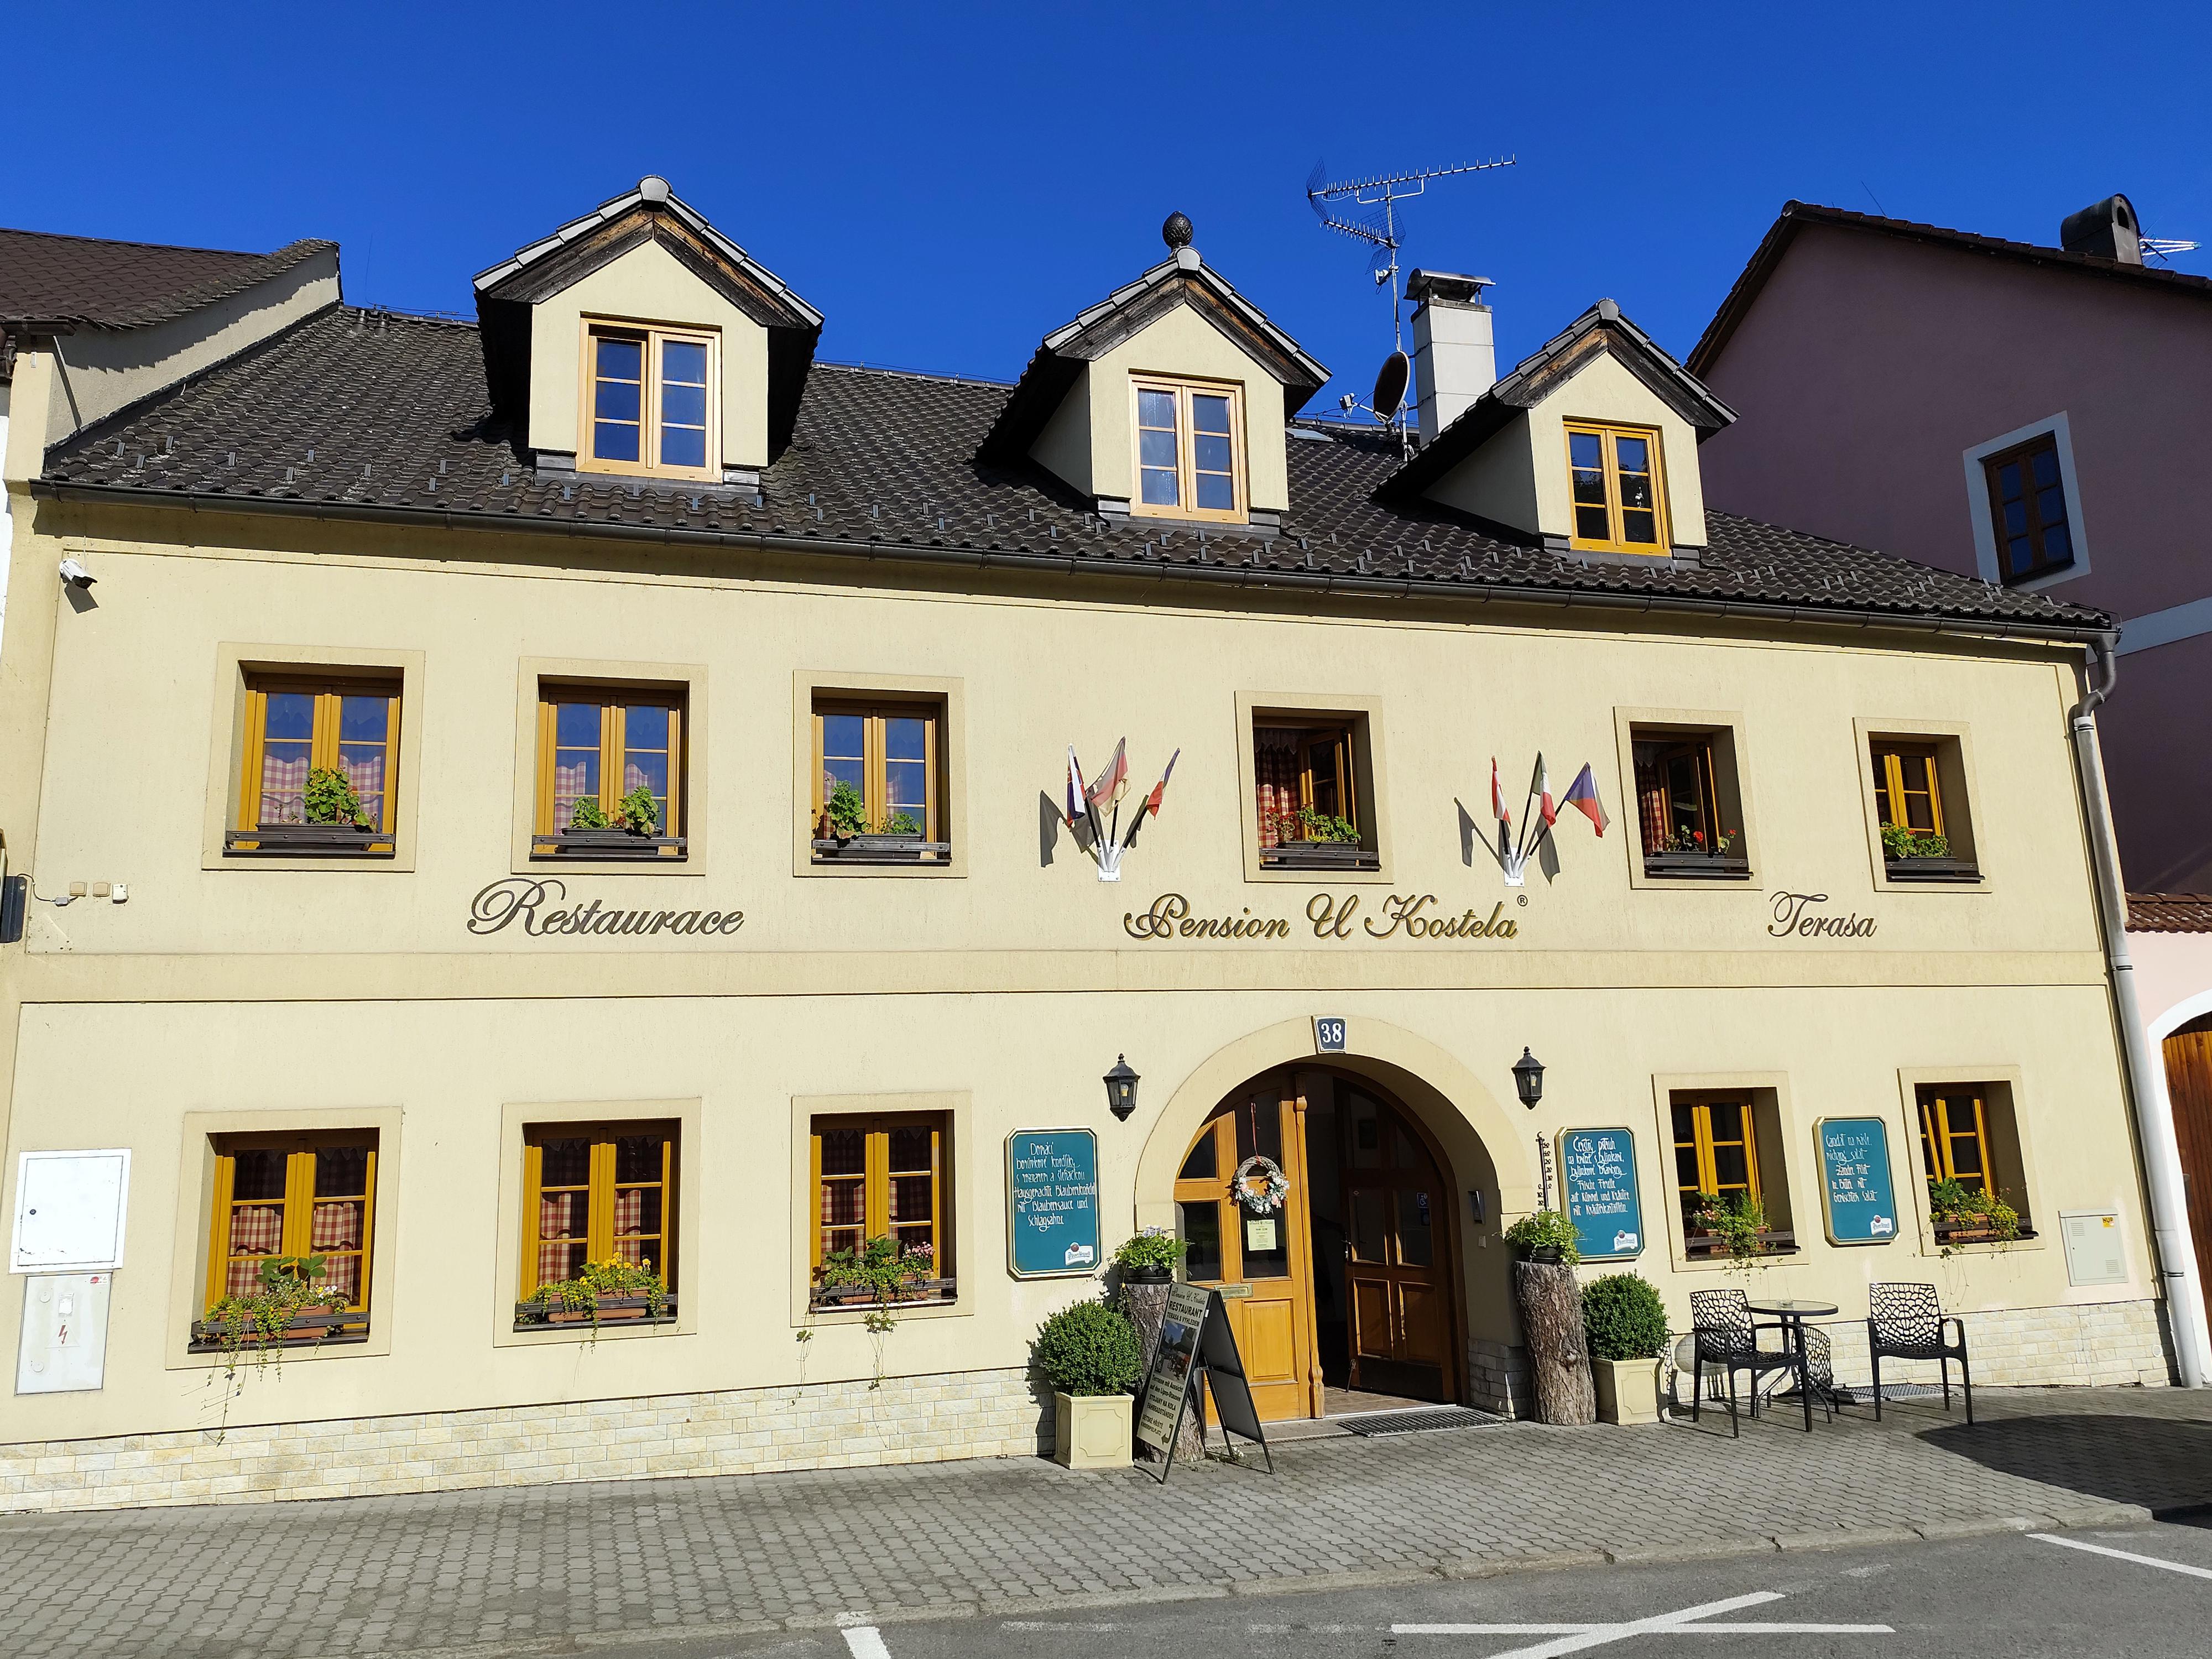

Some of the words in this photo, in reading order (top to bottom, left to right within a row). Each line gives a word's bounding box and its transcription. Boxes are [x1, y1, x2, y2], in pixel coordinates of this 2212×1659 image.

[467, 878, 744, 936] Restaurace
[1123, 893, 1290, 939] Pension
[1306, 893, 1359, 940] U
[1364, 894, 1518, 939] Kostela
[1767, 891, 1877, 937] Terasa
[1321, 1023, 1342, 1043] 38
[1848, 1136, 1854, 1145] na
[1567, 1156, 1574, 1164] na
[1594, 1155, 1597, 1163] s
[1016, 1173, 1019, 1183] s
[1050, 1172, 1054, 1182] a
[1857, 1177, 1867, 1188] mit
[1577, 1179, 1595, 1191] Frische
[1598, 1178, 1616, 1189] Forelle
[1014, 1185, 1052, 1203] Hausgemachte
[1571, 1192, 1579, 1202] auf
[1600, 1191, 1610, 1201] und
[1862, 1190, 1877, 1201] Salat
[1018, 1201, 1026, 1213] mit
[1077, 1197, 1088, 1209] und
[1027, 1213, 1065, 1232] Schlagsahne
[1168, 1301, 1203, 1318] RESTAURANT
[1167, 1312, 1178, 1321] TERASA
[1170, 1382, 1183, 1393] Aussicht
[1167, 1402, 1176, 1411] KOLA
